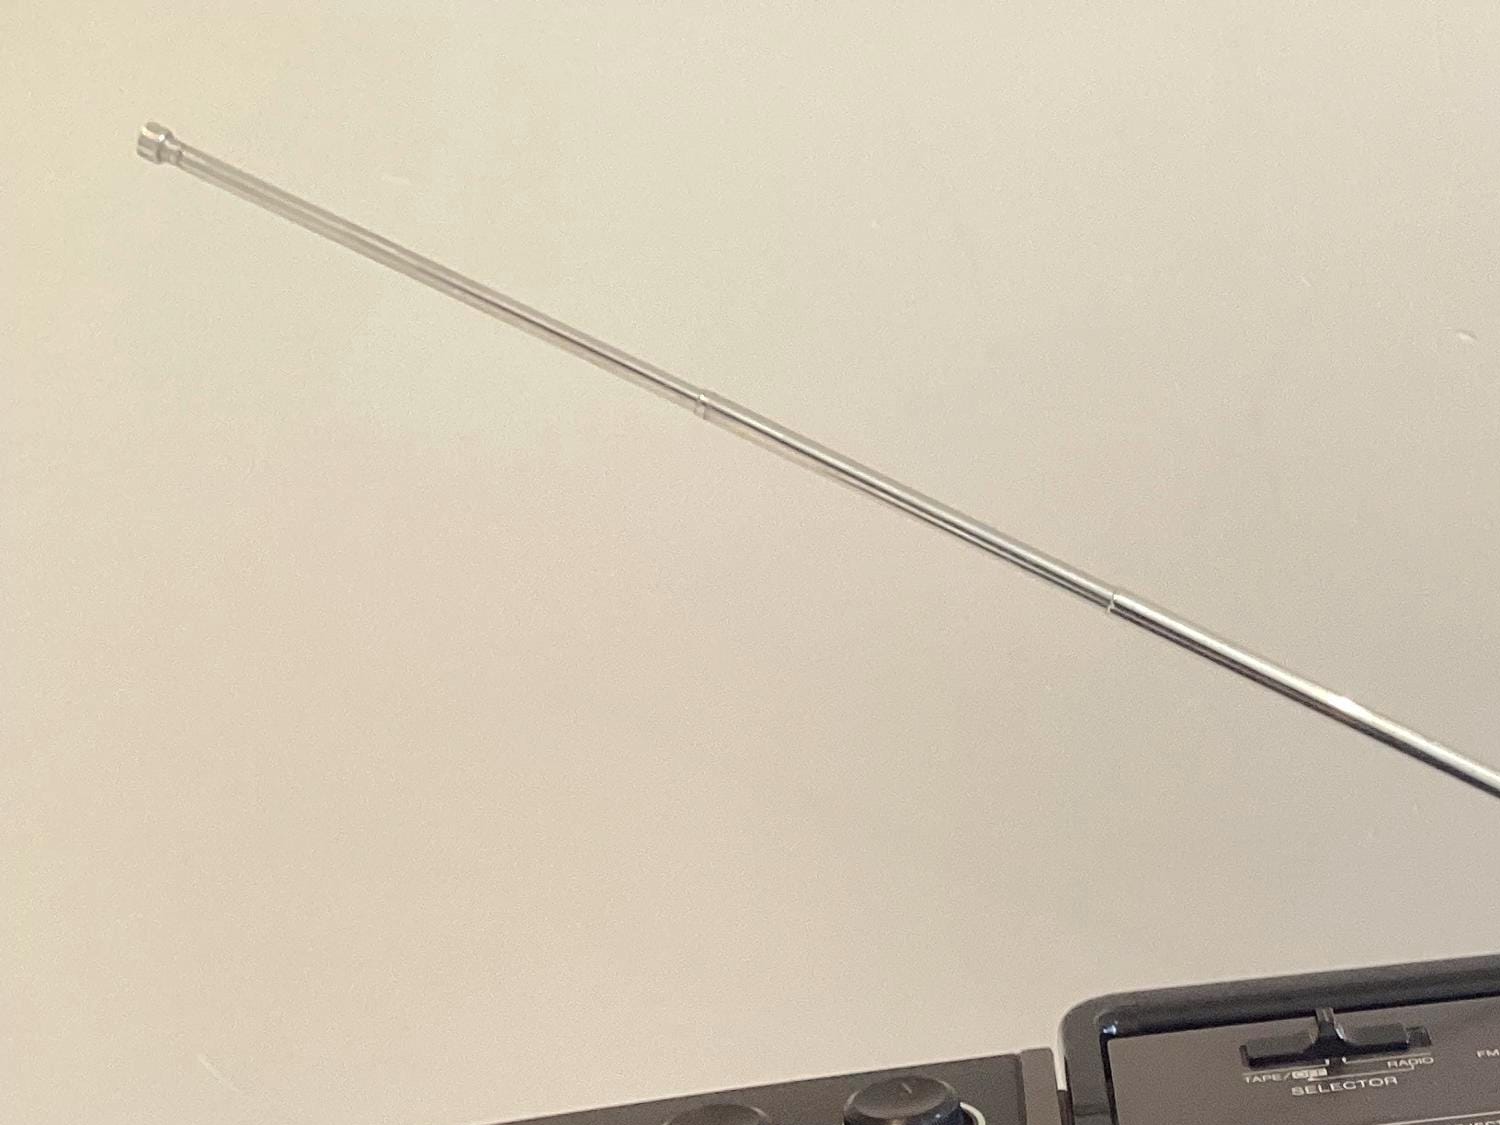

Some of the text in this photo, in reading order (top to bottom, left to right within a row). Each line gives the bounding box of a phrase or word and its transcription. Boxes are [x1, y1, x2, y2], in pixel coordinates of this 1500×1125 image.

[1476, 1048, 1500, 1059] FM
[1386, 1056, 1435, 1070] RADIO
[1291, 1075, 1398, 1097] SELECTOR
